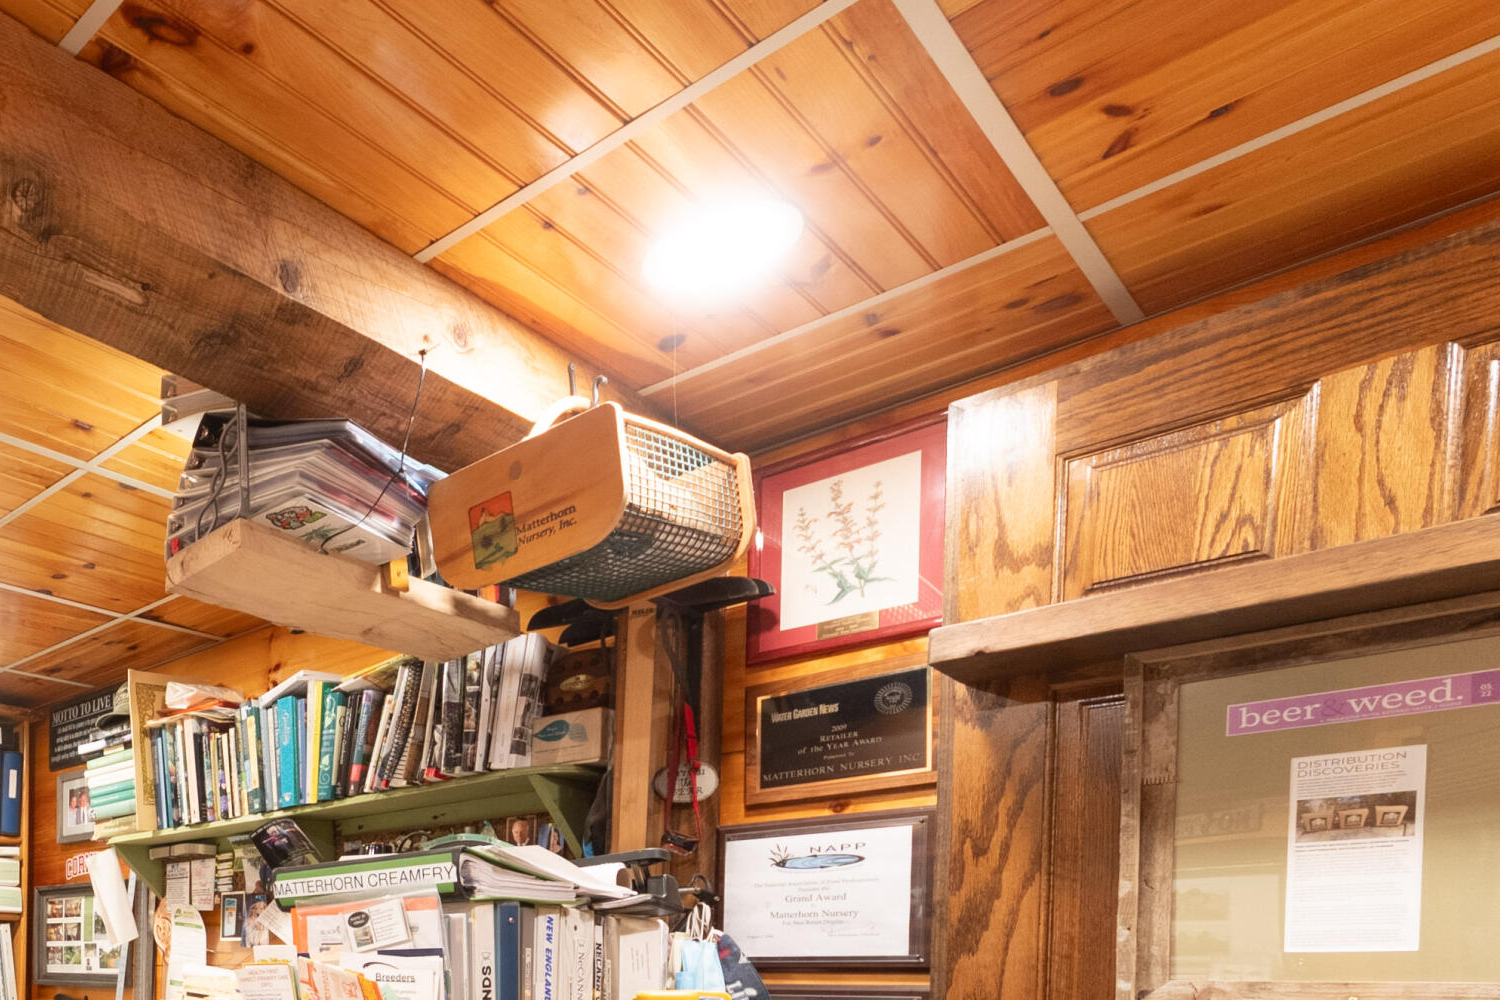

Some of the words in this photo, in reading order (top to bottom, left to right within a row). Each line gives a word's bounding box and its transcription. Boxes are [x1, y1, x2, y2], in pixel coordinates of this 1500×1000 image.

[514, 503, 577, 535] Matterhorn
[517, 526, 556, 548] Nursery,
[558, 516, 578, 531] Inc.
[52, 705, 79, 724] MOTTO
[80, 701, 91, 715] TO
[92, 694, 111, 712] LIVE
[771, 710, 793, 724] WATER
[793, 706, 818, 720] GARDEN
[819, 702, 839, 715] NEWS
[1238, 703, 1321, 729] beer
[1320, 698, 1346, 718] &
[1346, 677, 1464, 714] weed.
[797, 747, 808, 756] of
[810, 744, 824, 753] the
[826, 740, 850, 751] YEAR
[852, 736, 883, 748] AWARD
[819, 731, 859, 743] RETAILER
[763, 764, 835, 782] MATTERHORN
[840, 757, 893, 771] NURSERY
[1297, 751, 1408, 771] DISTRIBUTION
[1297, 760, 1400, 779] DISCOVERIES
[808, 842, 868, 855] NAPP
[66, 851, 92, 881] CORN
[273, 874, 364, 898] MATTERHORN
[367, 864, 454, 889] CREAMERY
[784, 893, 813, 904] Grand
[815, 891, 847, 902] Award
[769, 910, 819, 920] Matterhorn
[821, 908, 860, 919] Nursery
[546, 916, 555, 944] NEW
[375, 971, 416, 983] Breeders
